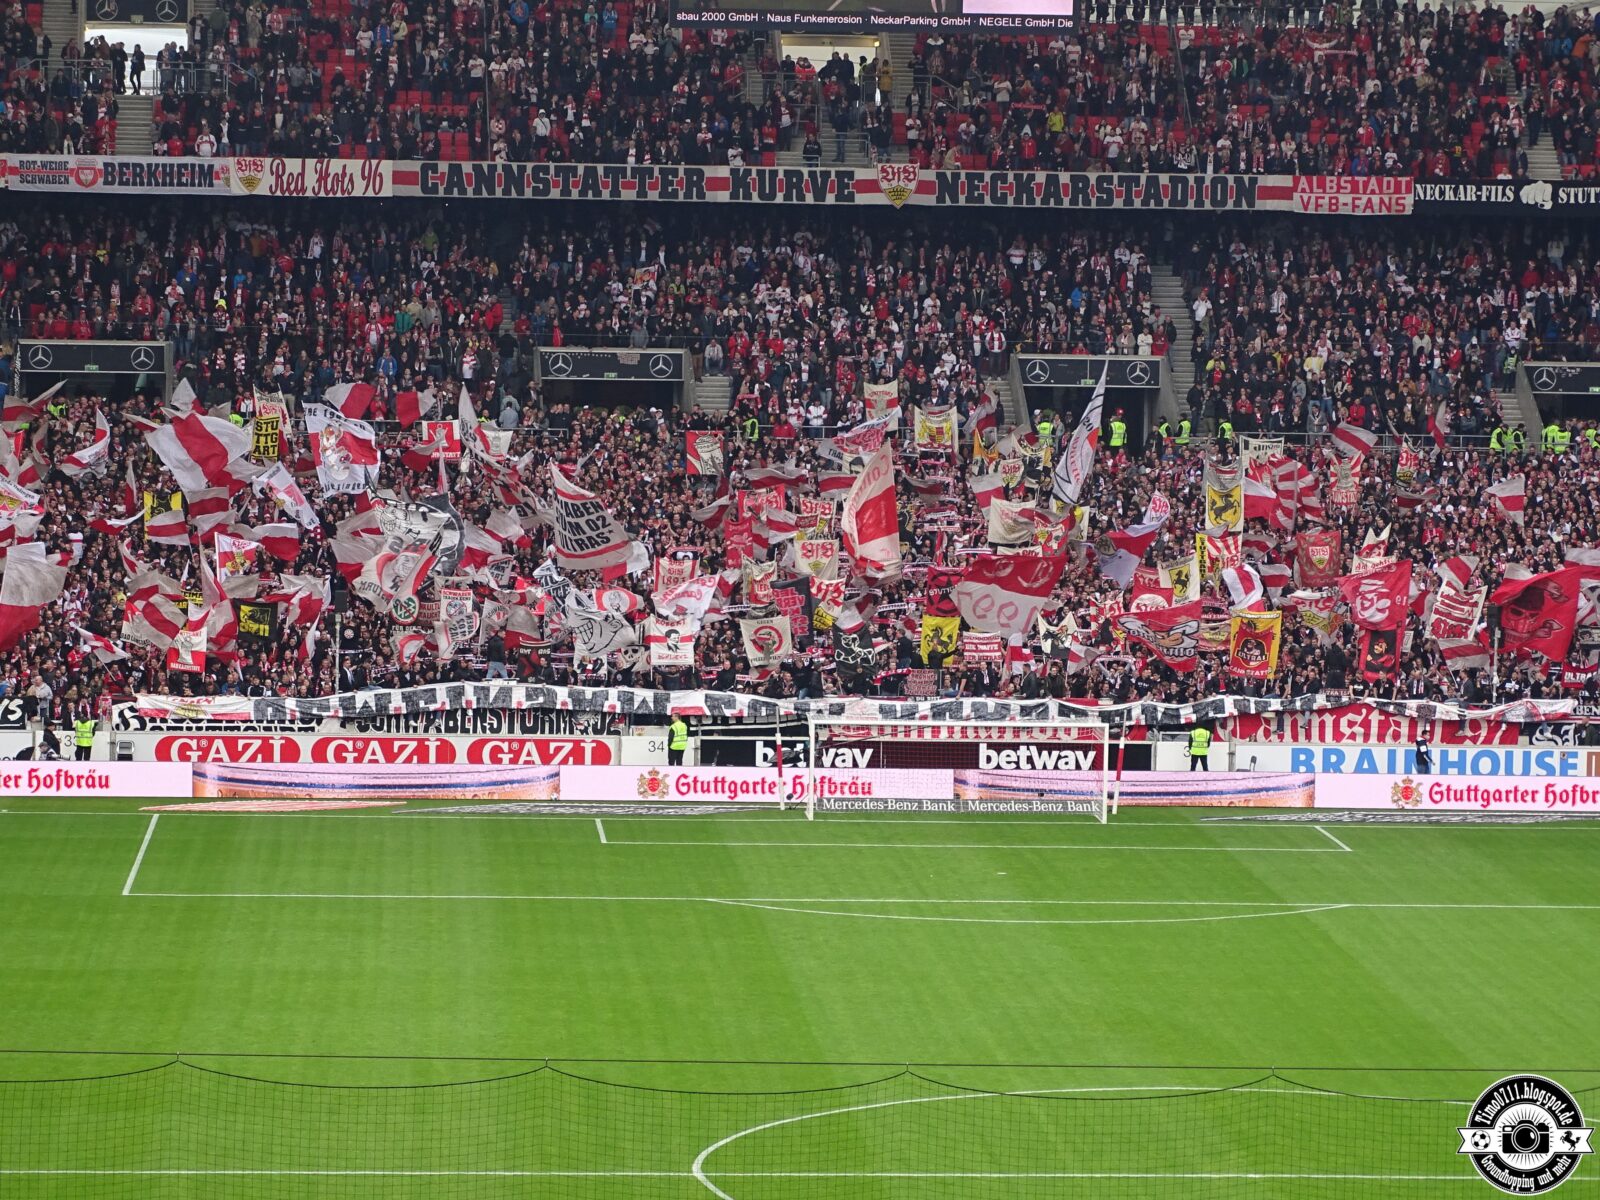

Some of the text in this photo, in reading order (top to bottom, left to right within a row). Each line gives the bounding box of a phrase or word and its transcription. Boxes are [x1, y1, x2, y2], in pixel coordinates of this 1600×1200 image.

[676, 12, 1074, 28] sbau 2000 GmbH Naus Funkenerosion NeckarParking GmbH NEGELE GmbH Die
[18, 173, 70, 185] SCHWABEN
[102, 161, 215, 188] BERKHEIM
[269, 157, 385, 197] Red Hots 96
[420, 162, 856, 203] CANNSTATTER KURVE
[936, 170, 1258, 209] NECKARSTADION
[1300, 176, 1411, 195] ALBSTADT
[1415, 183, 1515, 202] NECKAR-FILS
[1302, 195, 1407, 213] VFB-FANS
[256, 421, 279, 433] STU
[255, 433, 278, 445] TTG
[253, 445, 278, 456] ART
[648, 740, 665, 753] 34
[978, 743, 1096, 771] betway
[27, 768, 111, 793] Hofbräu
[1429, 781, 1539, 809] Stuttgarter
[923, 800, 956, 812] Bank
[968, 800, 1100, 812] Mercedes-Benz Bank
